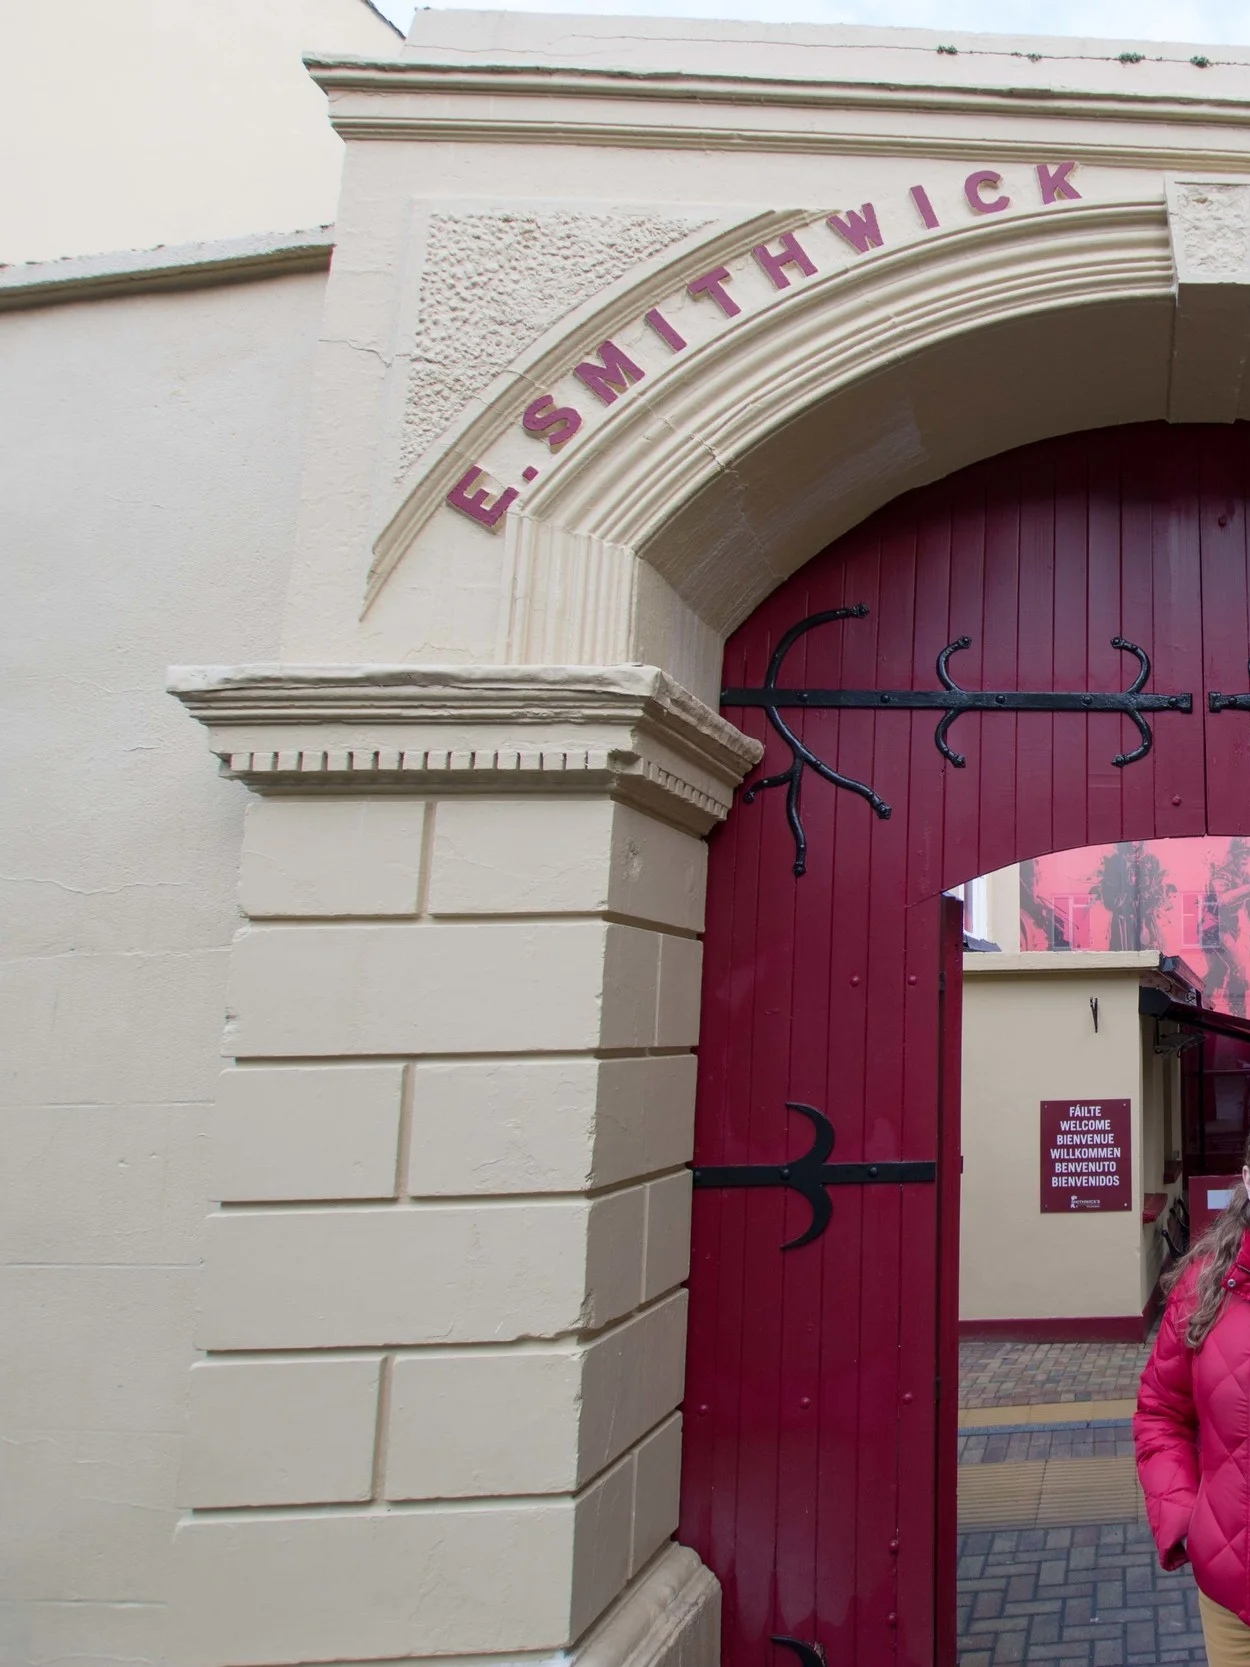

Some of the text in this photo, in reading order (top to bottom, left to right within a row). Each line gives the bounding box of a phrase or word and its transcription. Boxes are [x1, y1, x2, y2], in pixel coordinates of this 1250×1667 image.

[446, 161, 1083, 531] E. SMITHWICK
[1069, 1104, 1101, 1117] FÁILTE
[1060, 1120, 1111, 1131] WELCOME
[1056, 1134, 1114, 1145] BIENVENUE
[1050, 1147, 1121, 1159] WILLKOMMEN
[1055, 1161, 1116, 1173] BENVENUTO
[1051, 1175, 1120, 1187] BIENVENIDOS
